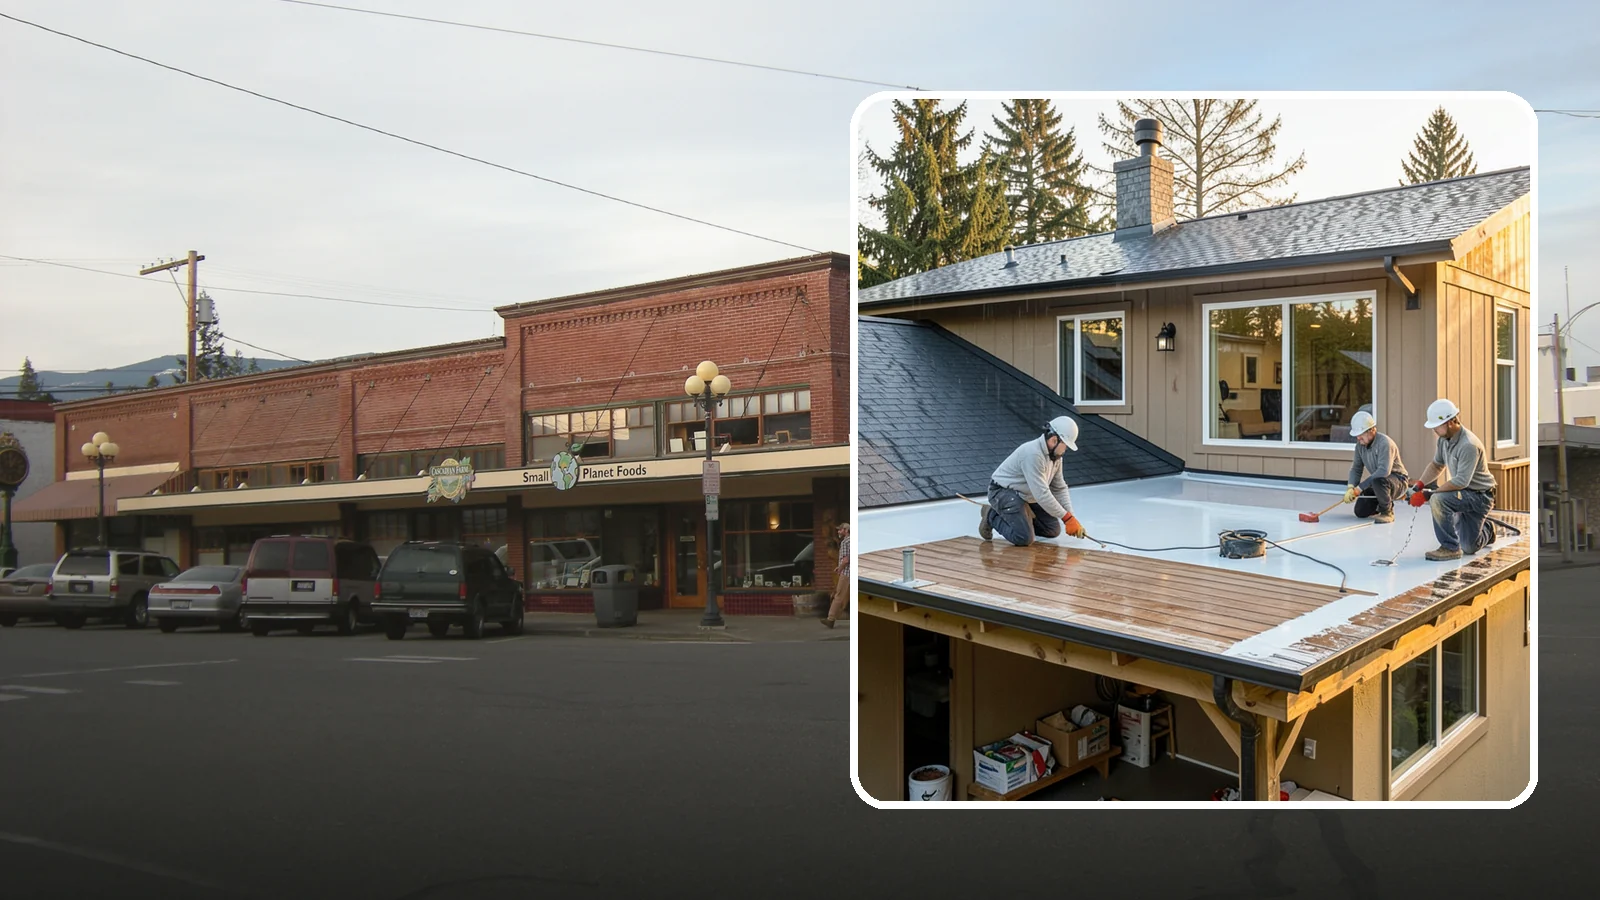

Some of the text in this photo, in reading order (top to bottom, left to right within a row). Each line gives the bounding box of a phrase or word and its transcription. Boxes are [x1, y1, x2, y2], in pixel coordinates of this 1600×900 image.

[523, 464, 647, 483] Small Planet Foods
